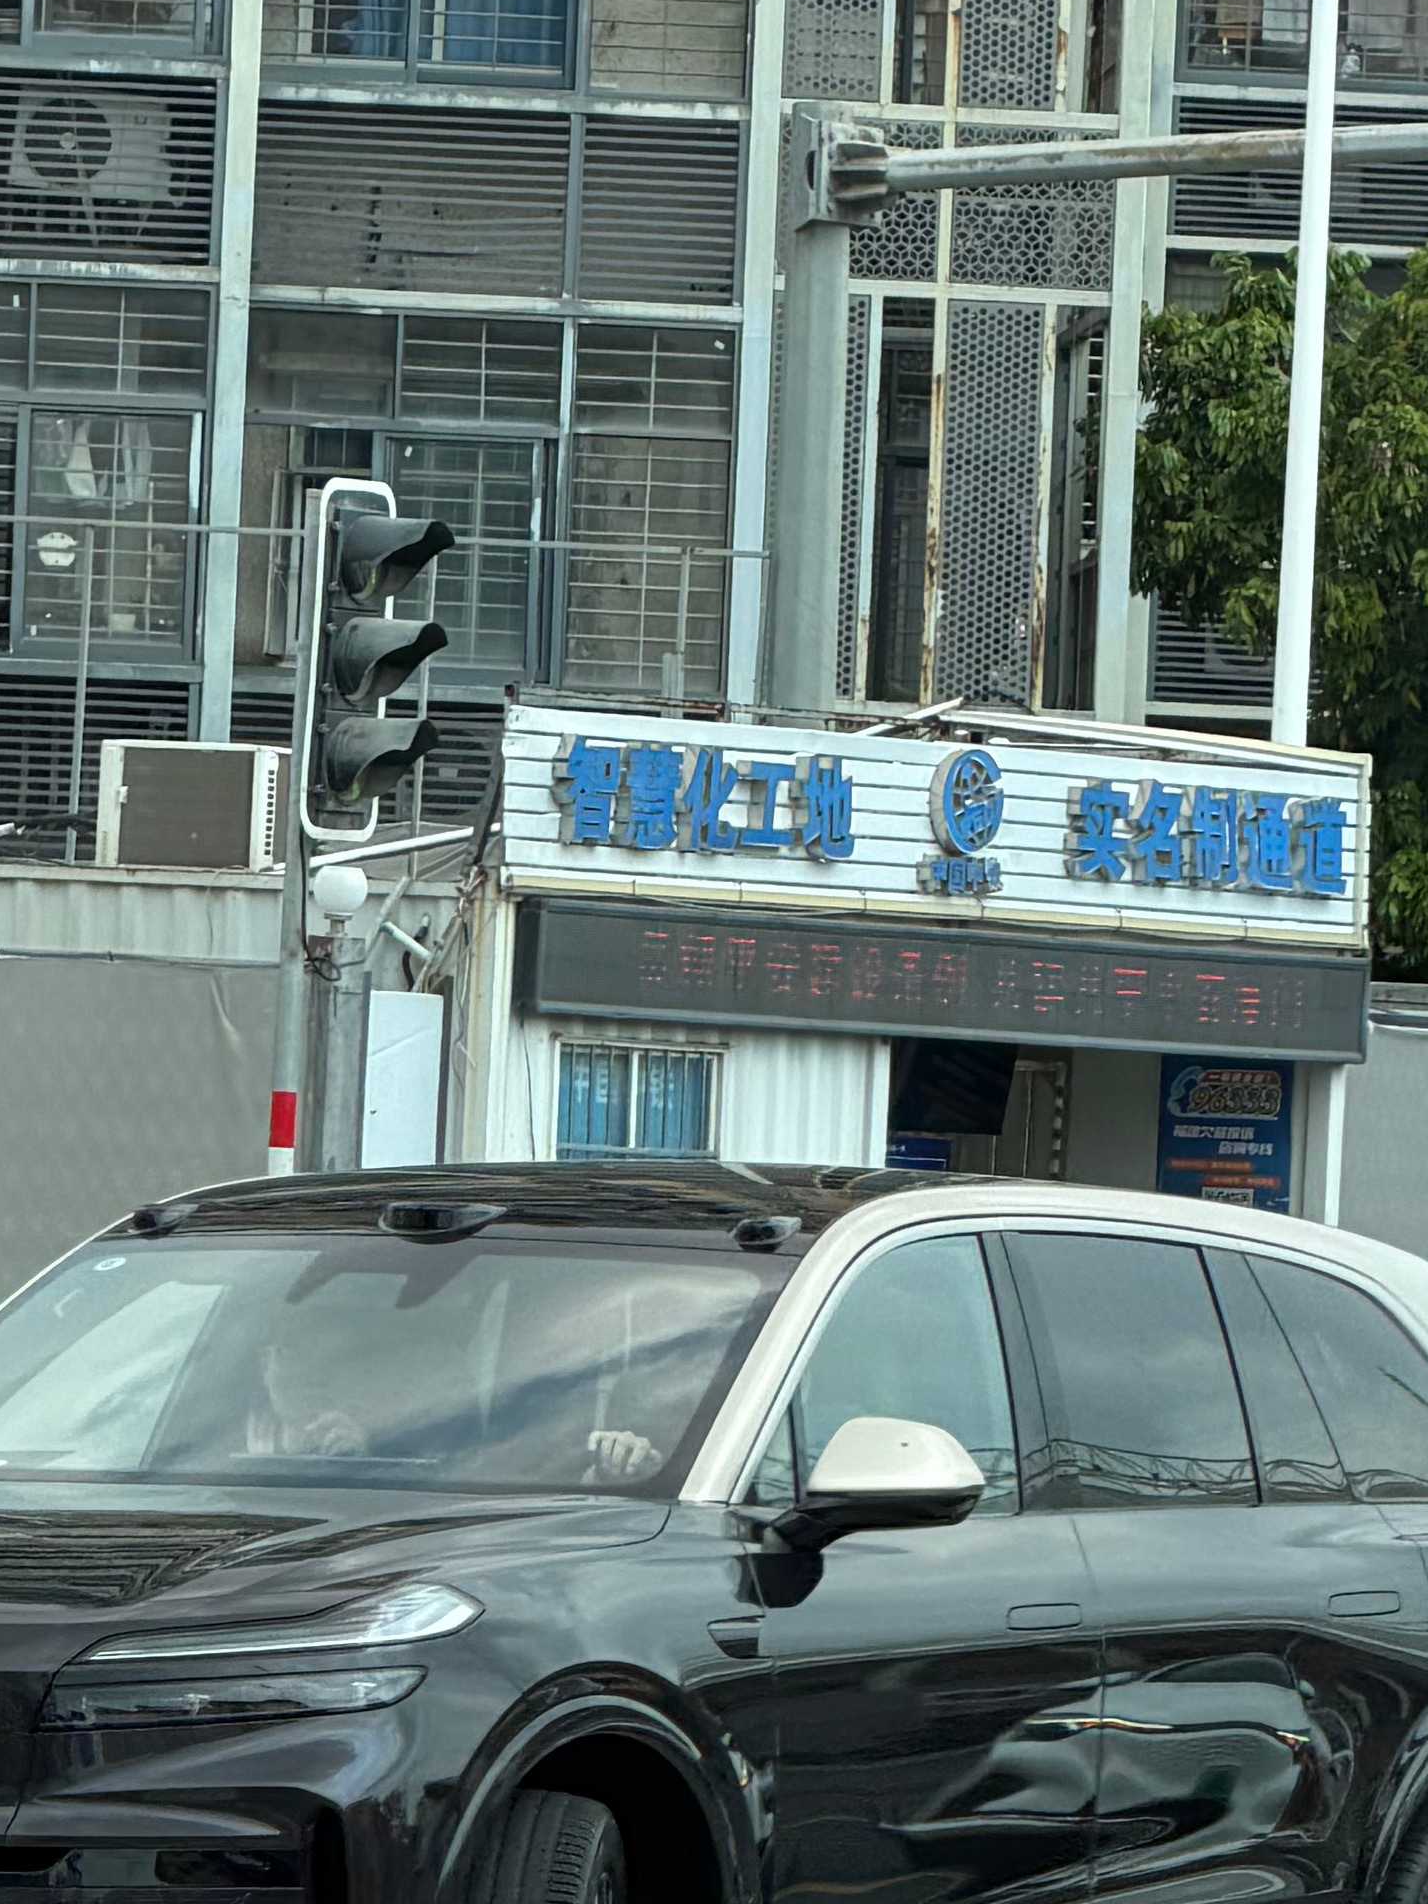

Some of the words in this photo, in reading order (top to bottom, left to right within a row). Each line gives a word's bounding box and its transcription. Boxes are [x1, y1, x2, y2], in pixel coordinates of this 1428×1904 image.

[564, 735, 856, 860] 智慧化工地
[1072, 780, 1347, 895] 实名制通道
